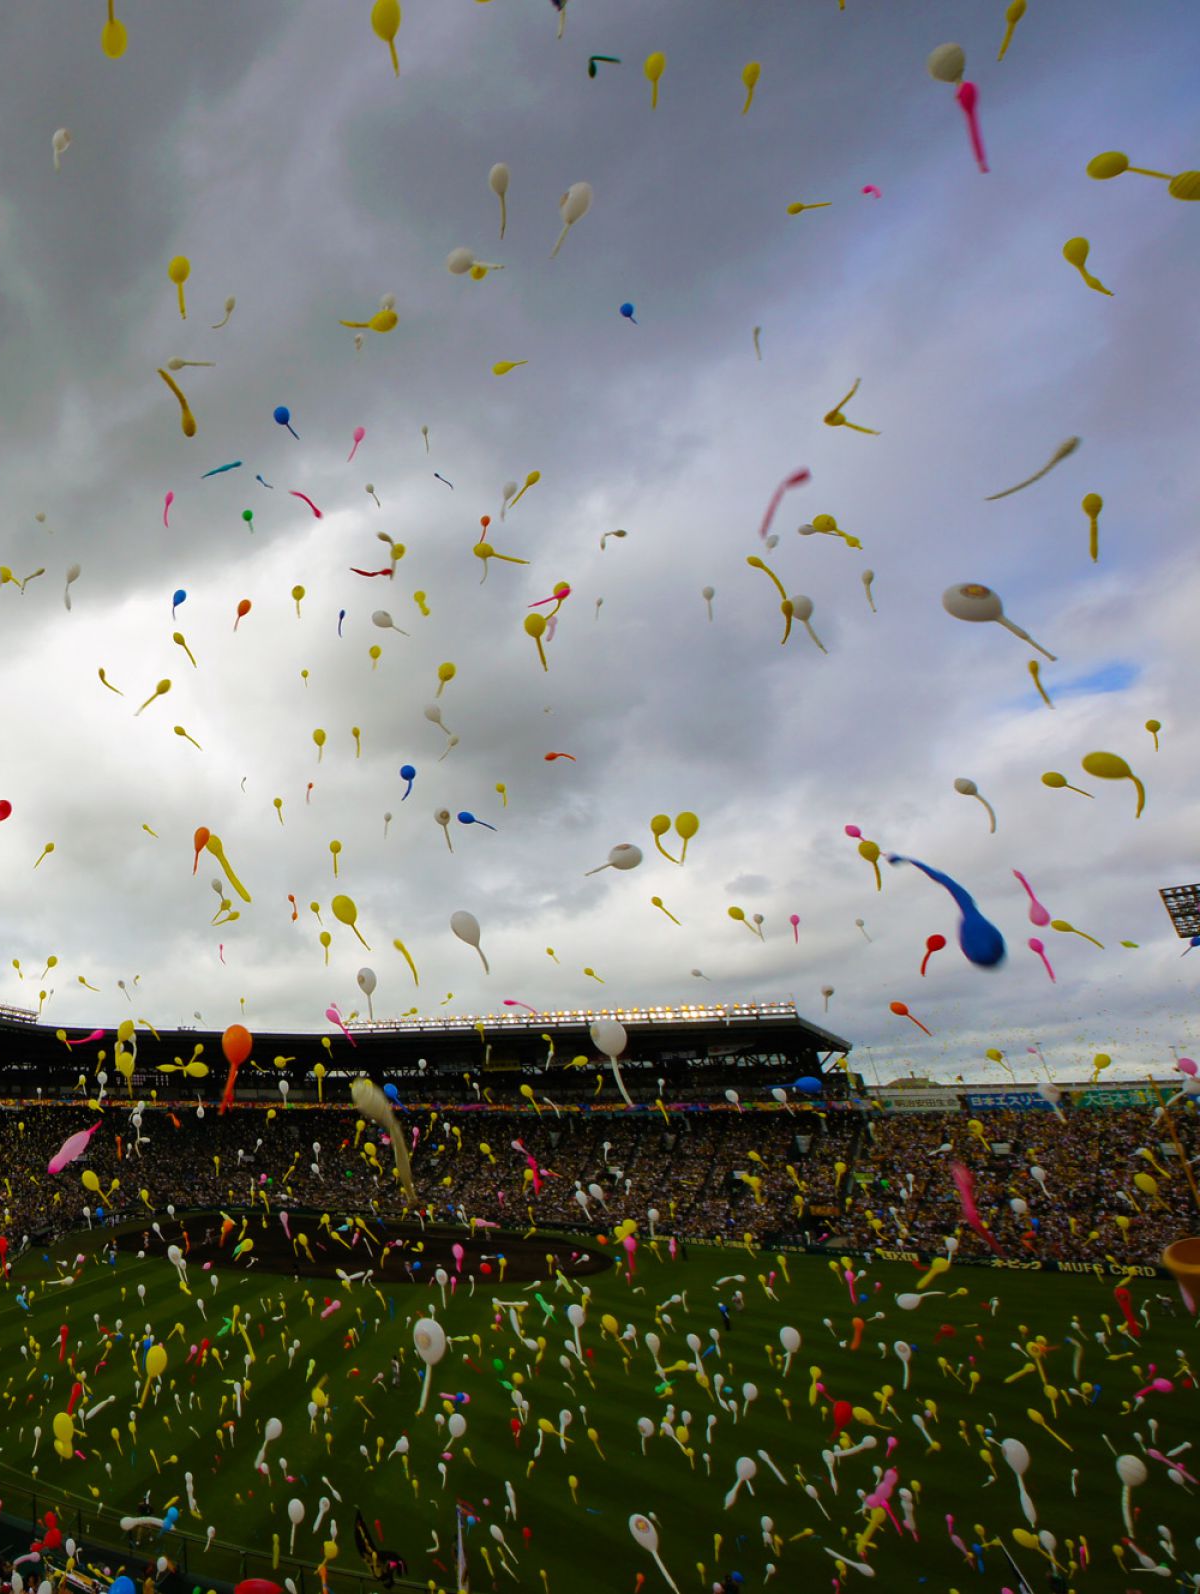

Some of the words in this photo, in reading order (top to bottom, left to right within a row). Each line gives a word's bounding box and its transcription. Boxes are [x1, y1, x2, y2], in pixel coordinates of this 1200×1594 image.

[970, 1095, 1048, 1107] 日本エスリー
